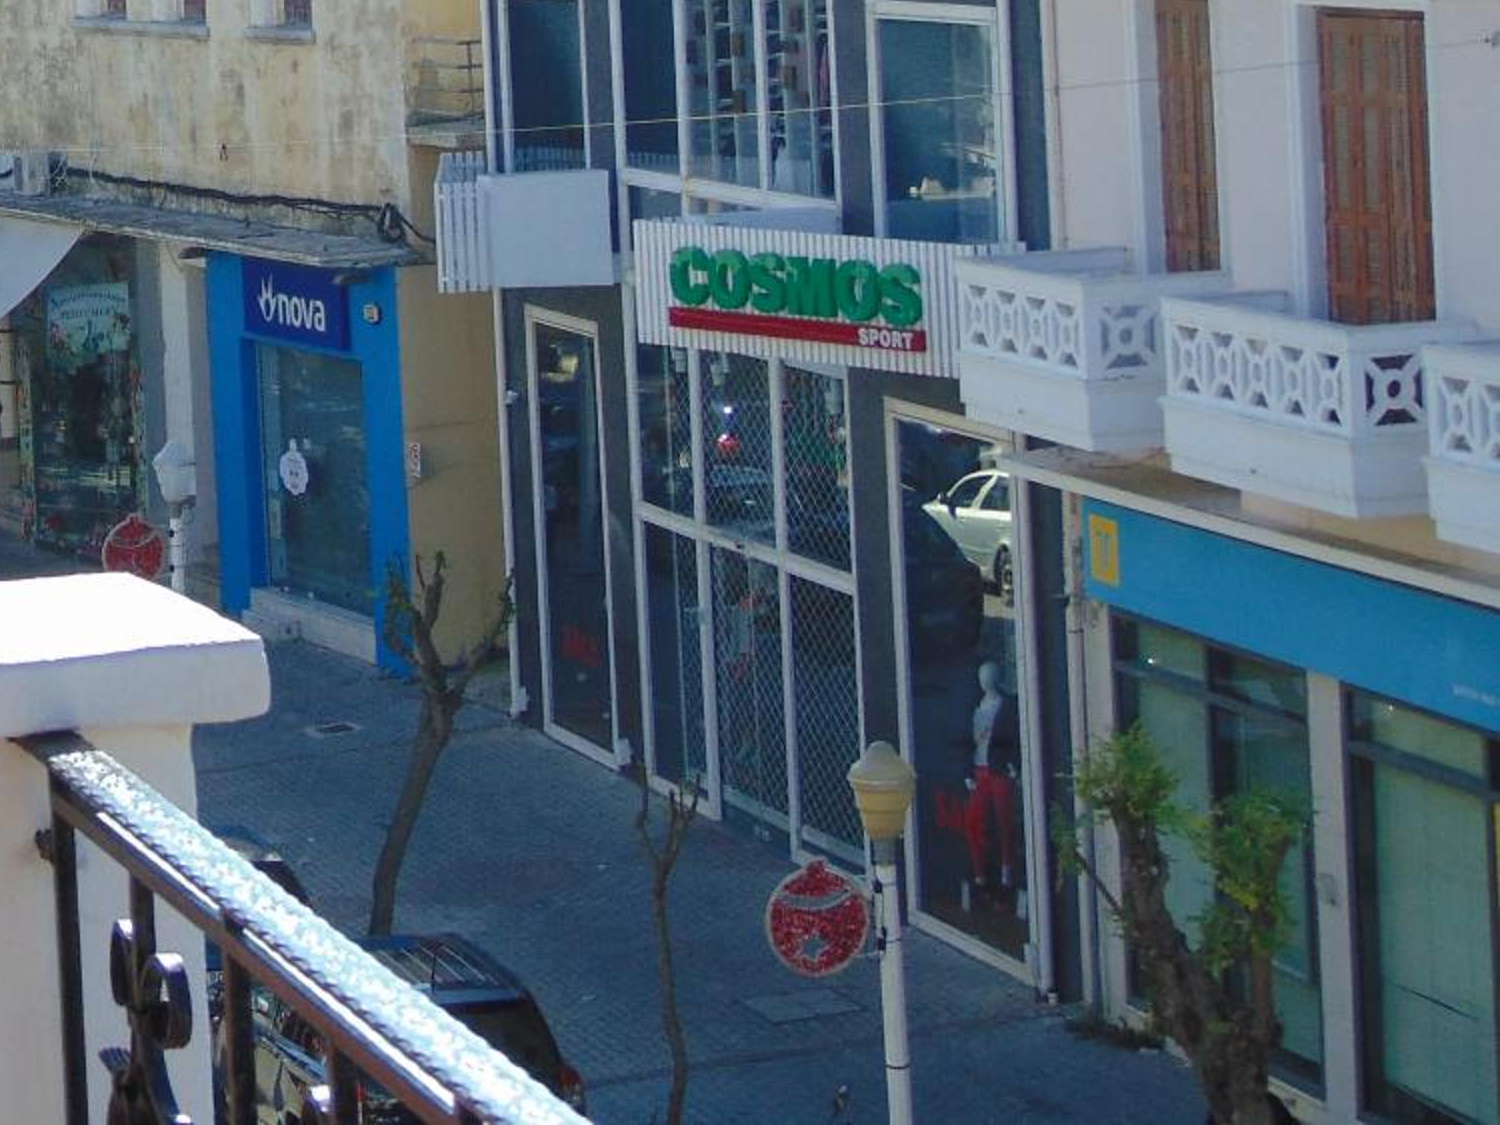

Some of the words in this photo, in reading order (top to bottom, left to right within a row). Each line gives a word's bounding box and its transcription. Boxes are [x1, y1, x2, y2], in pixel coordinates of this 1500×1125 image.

[670, 245, 924, 327] COSMOS
[277, 293, 326, 332] nova
[858, 327, 914, 349] SPORT
